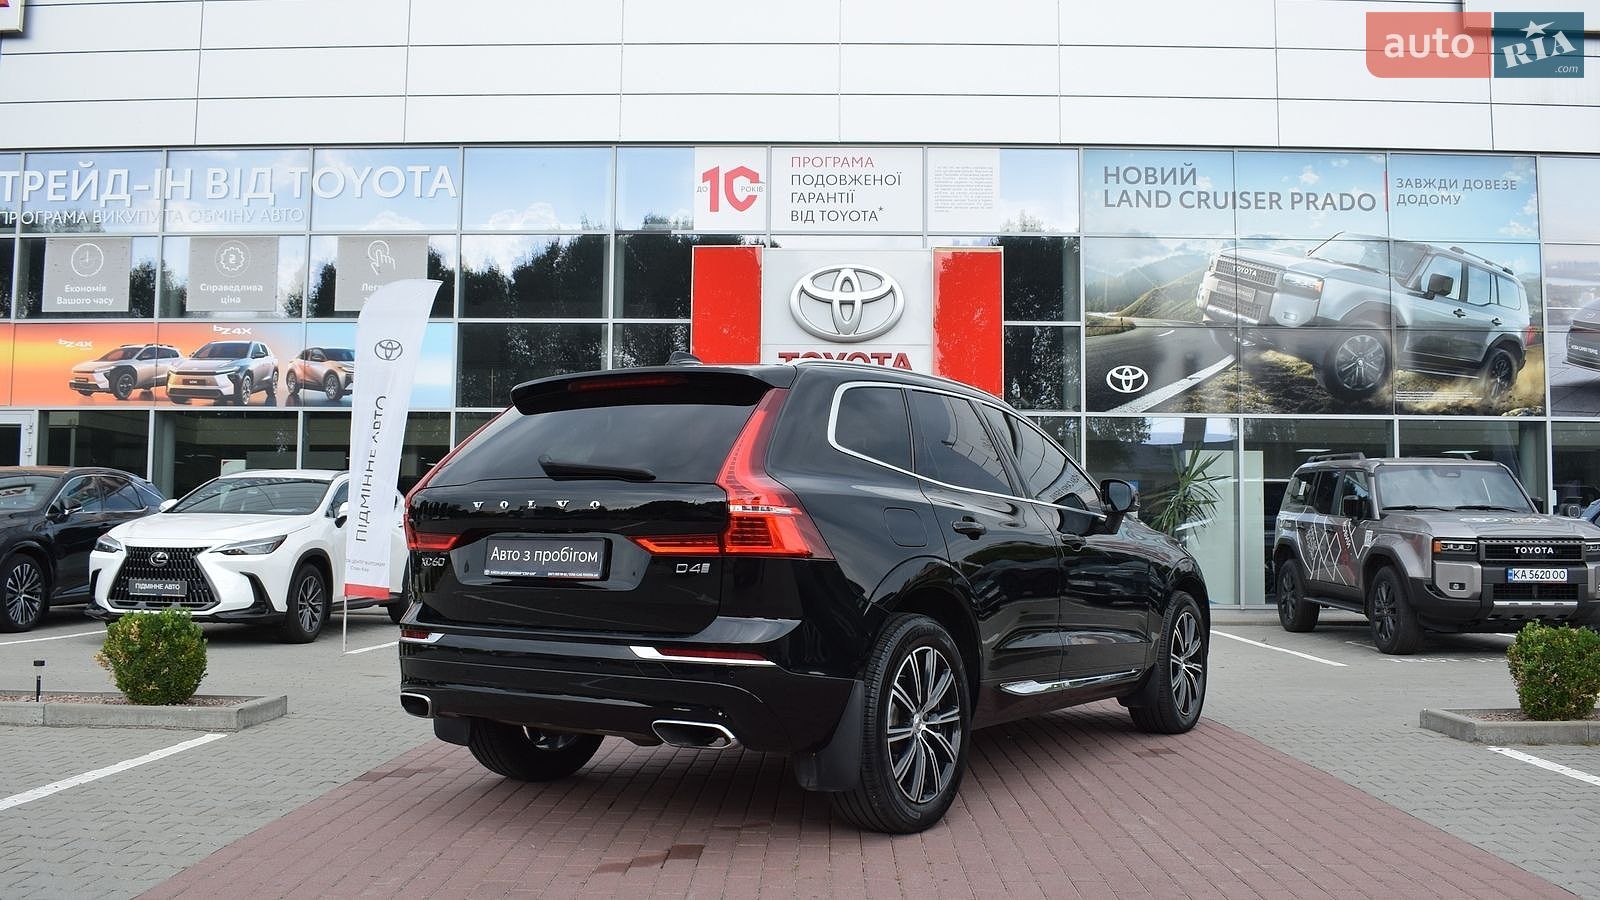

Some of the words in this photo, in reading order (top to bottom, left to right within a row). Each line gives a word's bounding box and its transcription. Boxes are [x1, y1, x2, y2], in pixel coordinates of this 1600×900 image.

[791, 156, 875, 168] ПРОГРАМА
[791, 171, 902, 188] ПОДОВЖЕНОЇ
[1104, 162, 1197, 186] НОВИЙ
[0, 161, 192, 208] ТРЕЙД-ІН
[207, 167, 276, 208] ВІД
[288, 165, 458, 200] TOYOTA
[1396, 178, 1459, 191] ЗАВЖДИ
[1463, 179, 1518, 191] ДОВЕЗЕ
[791, 189, 856, 204] ГАРАНТІЇ
[1104, 189, 1172, 209] LAND
[1179, 190, 1283, 210] CRUISER
[1290, 192, 1377, 212] PRADO
[1396, 194, 1462, 207] ДОДОМУ
[0, 210, 88, 225] ПРОГРАМА
[93, 210, 162, 225] ВИКУПУ
[189, 209, 255, 224] ОБМІНУ
[261, 208, 304, 224] АВТО
[791, 210, 816, 224] ВІД
[64, 283, 107, 293] Економія
[200, 283, 263, 293] Справедлива
[56, 297, 91, 305] Вашого
[93, 297, 114, 306] часу
[220, 297, 242, 306] ціна
[472, 500, 601, 512] VOLVO
[491, 546, 520, 561] Авто
[523, 549, 531, 561] з
[534, 546, 599, 566] пробігом
[1514, 546, 1554, 554] TOYOTA
[421, 557, 446, 567] XC60
[1513, 570, 1527, 580] KA
[1529, 570, 1551, 580] 5620
